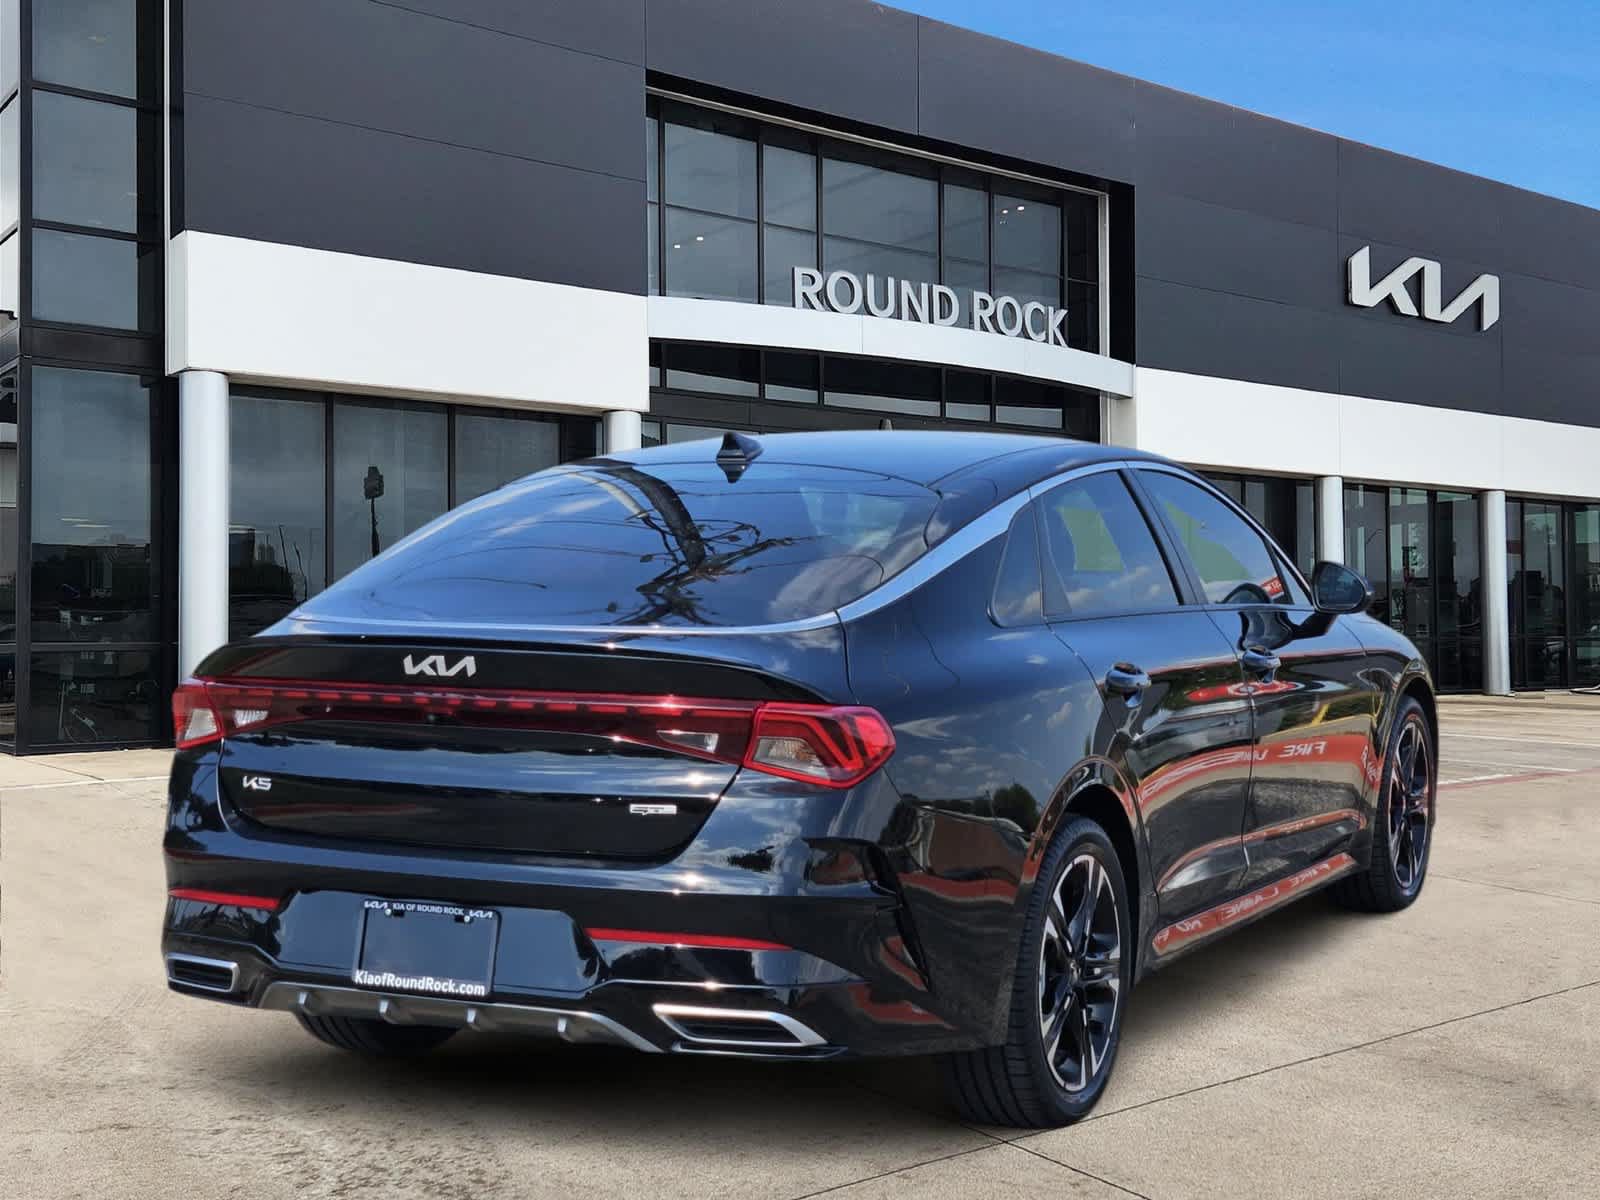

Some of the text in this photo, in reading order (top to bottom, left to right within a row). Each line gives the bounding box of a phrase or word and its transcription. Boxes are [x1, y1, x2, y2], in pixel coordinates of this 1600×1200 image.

[1347, 245, 1500, 331] KIA
[792, 265, 1069, 348] ROUND ROCK
[403, 654, 477, 678] KIA
[242, 775, 272, 791] K5
[364, 901, 388, 909] KIA
[406, 903, 416, 911] OF
[417, 904, 442, 914] ROUND
[443, 907, 465, 916] ROCK
[469, 909, 493, 918] KIA
[354, 970, 486, 996] KiaofRoundRock.com
